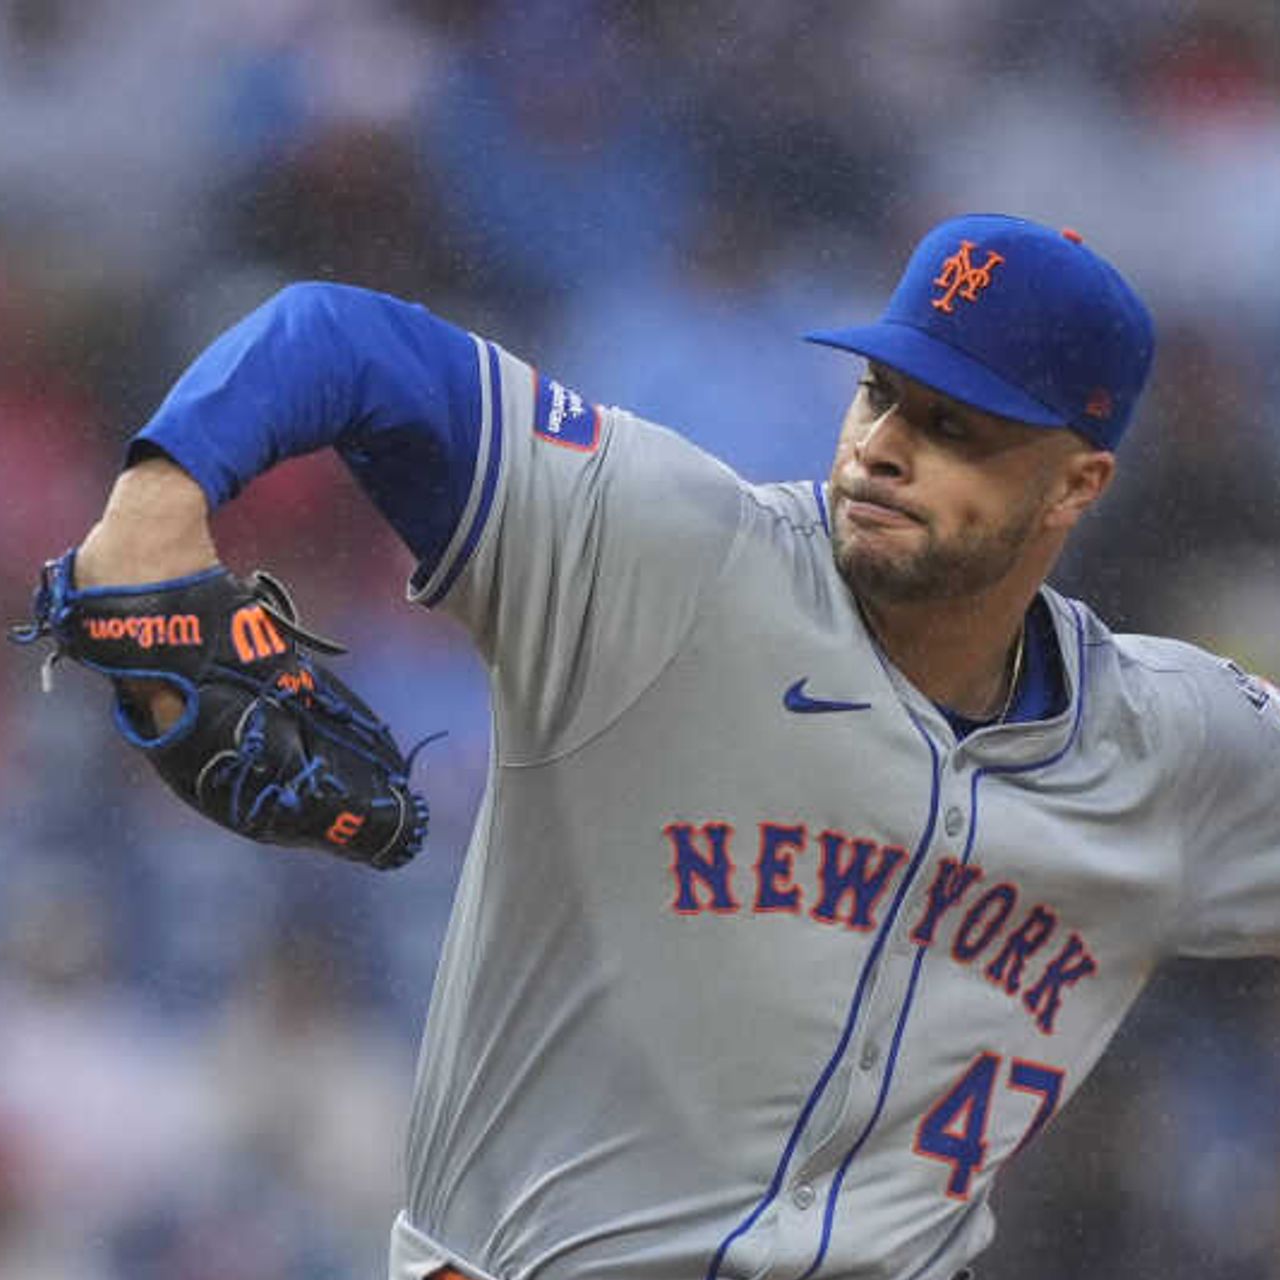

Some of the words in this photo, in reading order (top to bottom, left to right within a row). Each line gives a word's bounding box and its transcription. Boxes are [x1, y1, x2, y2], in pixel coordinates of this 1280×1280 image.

[86, 613, 203, 649] Wilson
[663, 822, 909, 933] NEW
[909, 856, 1098, 1035] YORK
[913, 1050, 1066, 1201] 47
